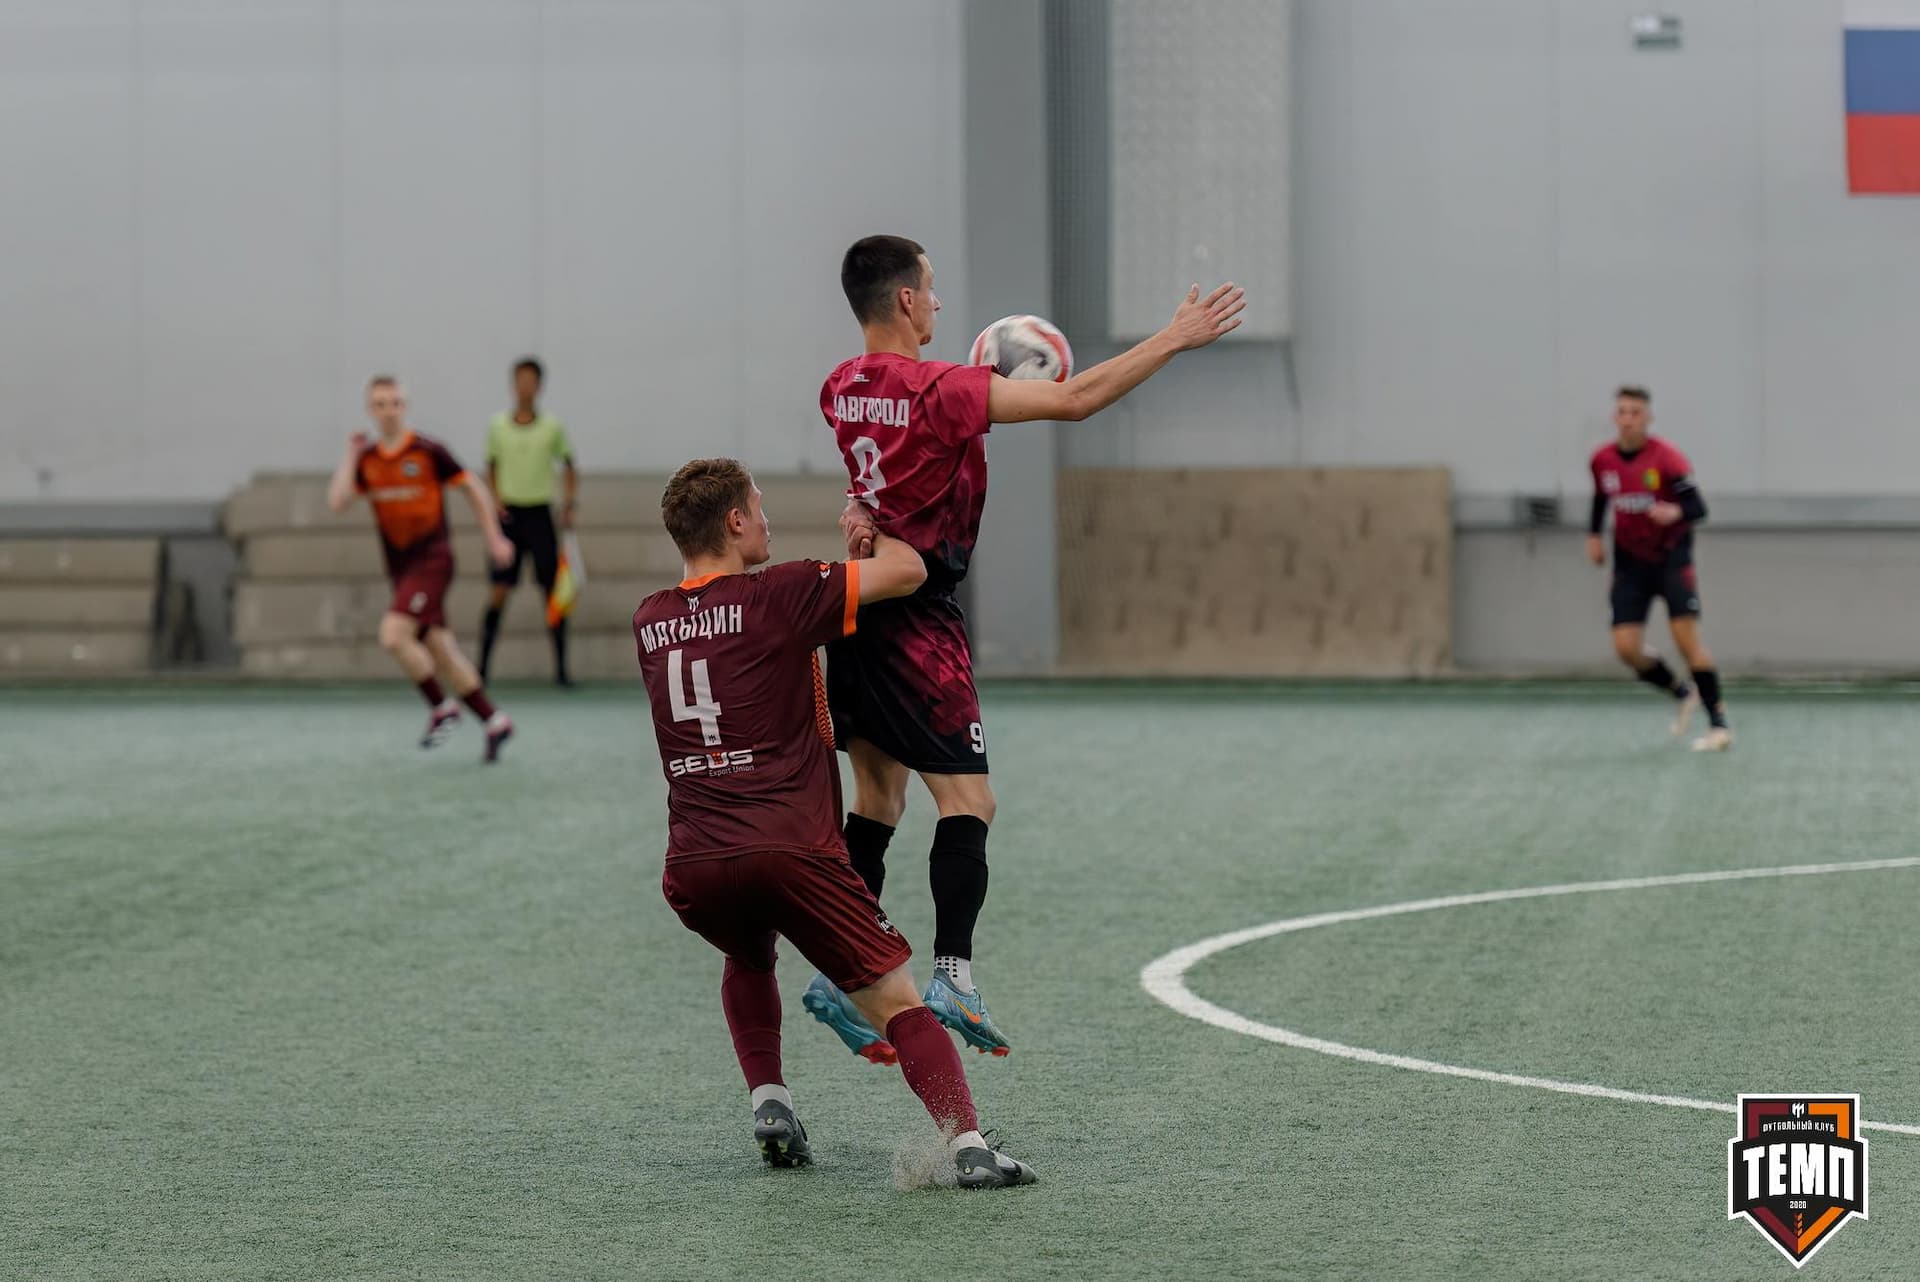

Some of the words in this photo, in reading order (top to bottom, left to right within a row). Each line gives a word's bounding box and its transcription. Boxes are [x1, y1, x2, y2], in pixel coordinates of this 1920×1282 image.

[640, 604, 743, 654] МАТЫЦИН
[667, 648, 722, 747] 4
[968, 722, 986, 754] 9
[669, 749, 754, 778] SEUS
[708, 767, 732, 777] Export
